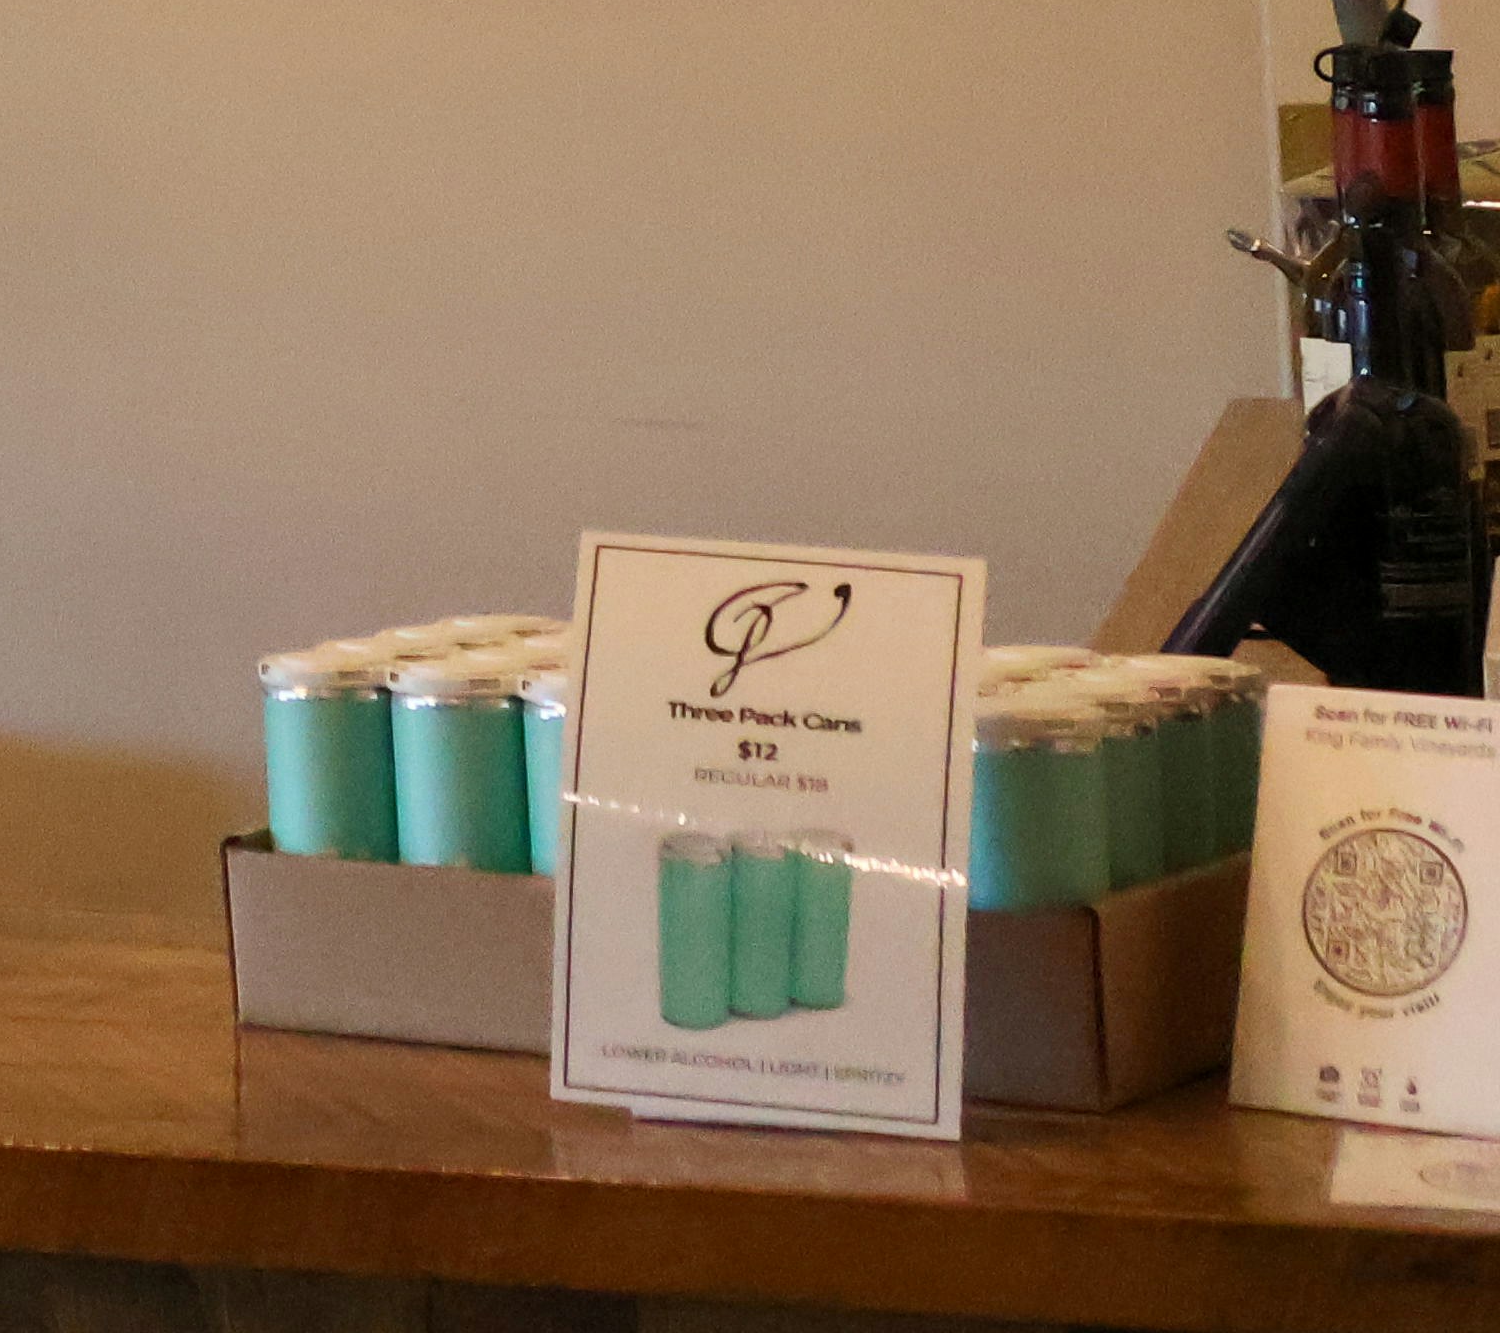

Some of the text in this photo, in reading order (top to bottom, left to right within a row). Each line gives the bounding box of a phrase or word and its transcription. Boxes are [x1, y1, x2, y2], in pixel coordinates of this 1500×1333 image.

[668, 700, 864, 733] Three Pack Cans
[1314, 705, 1359, 723] Scan
[1362, 708, 1387, 725] for
[1393, 711, 1438, 730] FREE
[737, 739, 780, 762] $12
[694, 766, 791, 790] REGULAR
